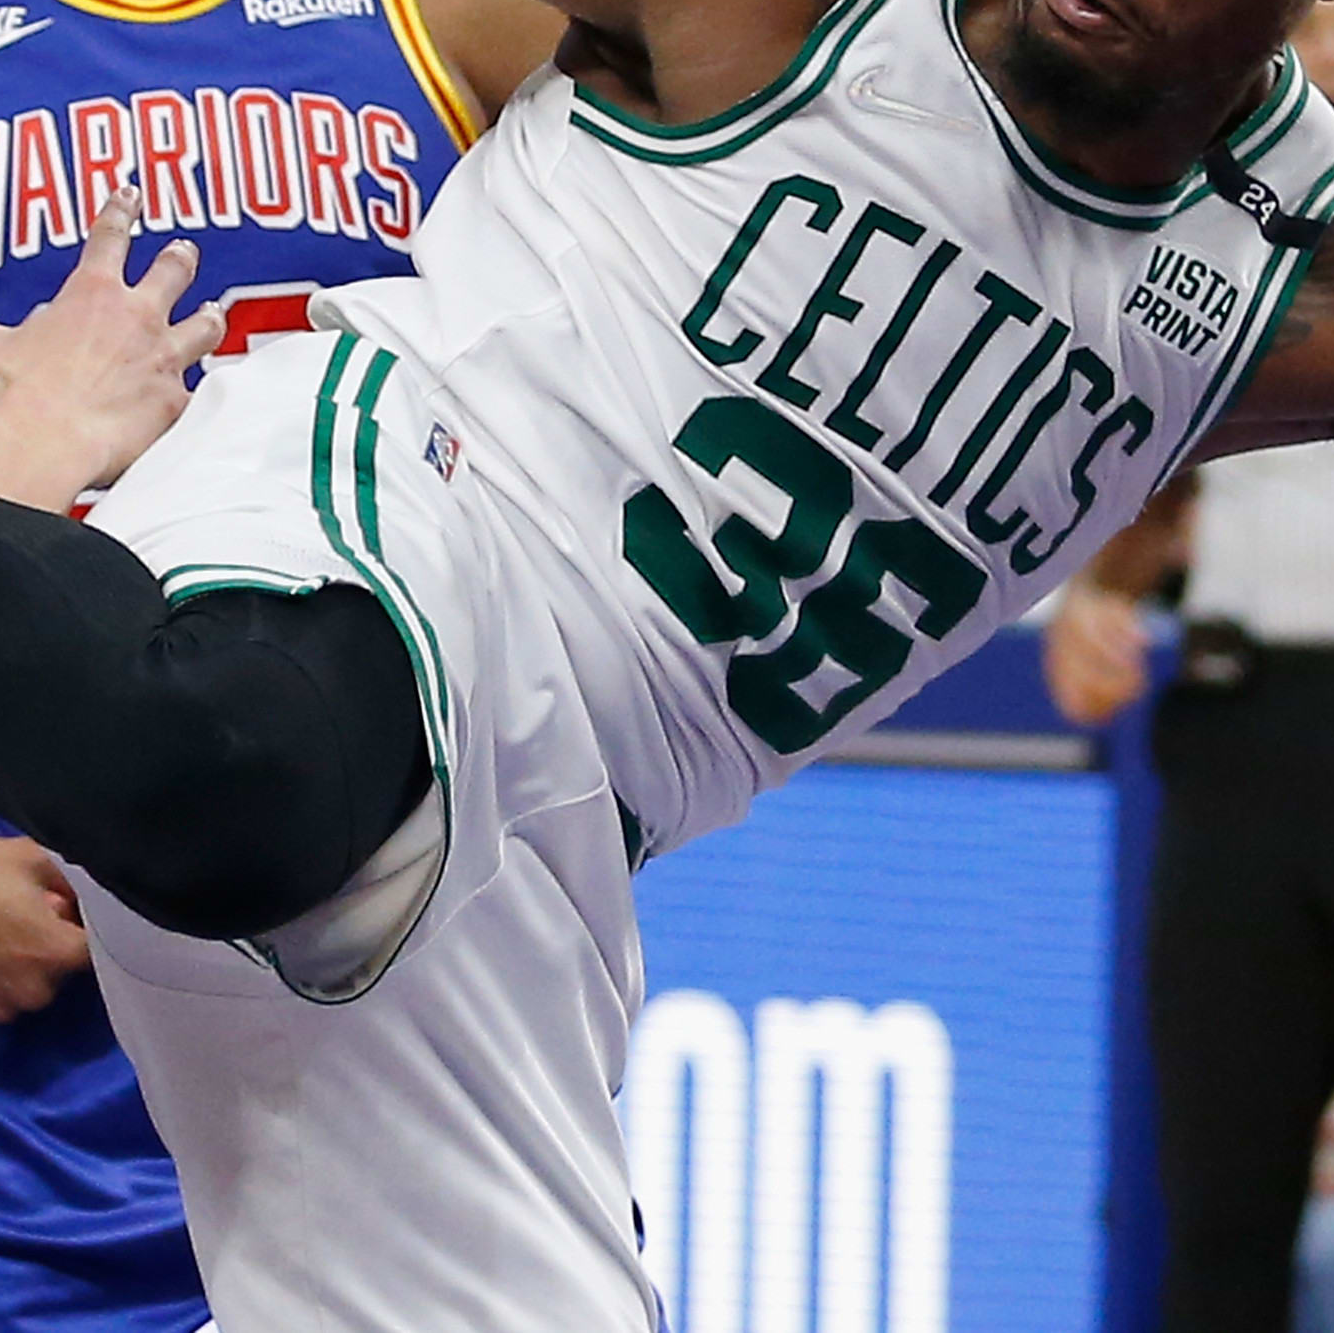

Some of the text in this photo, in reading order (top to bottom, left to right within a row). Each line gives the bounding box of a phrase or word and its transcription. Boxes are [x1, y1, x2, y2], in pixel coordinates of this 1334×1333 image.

[1146, 245, 1239, 332] VISTA
[1239, 183, 1276, 226] 24
[681, 174, 1155, 577] CELTICS
[1124, 284, 1218, 357] PRINT
[623, 396, 988, 756] 36
[627, 988, 954, 1333] om
